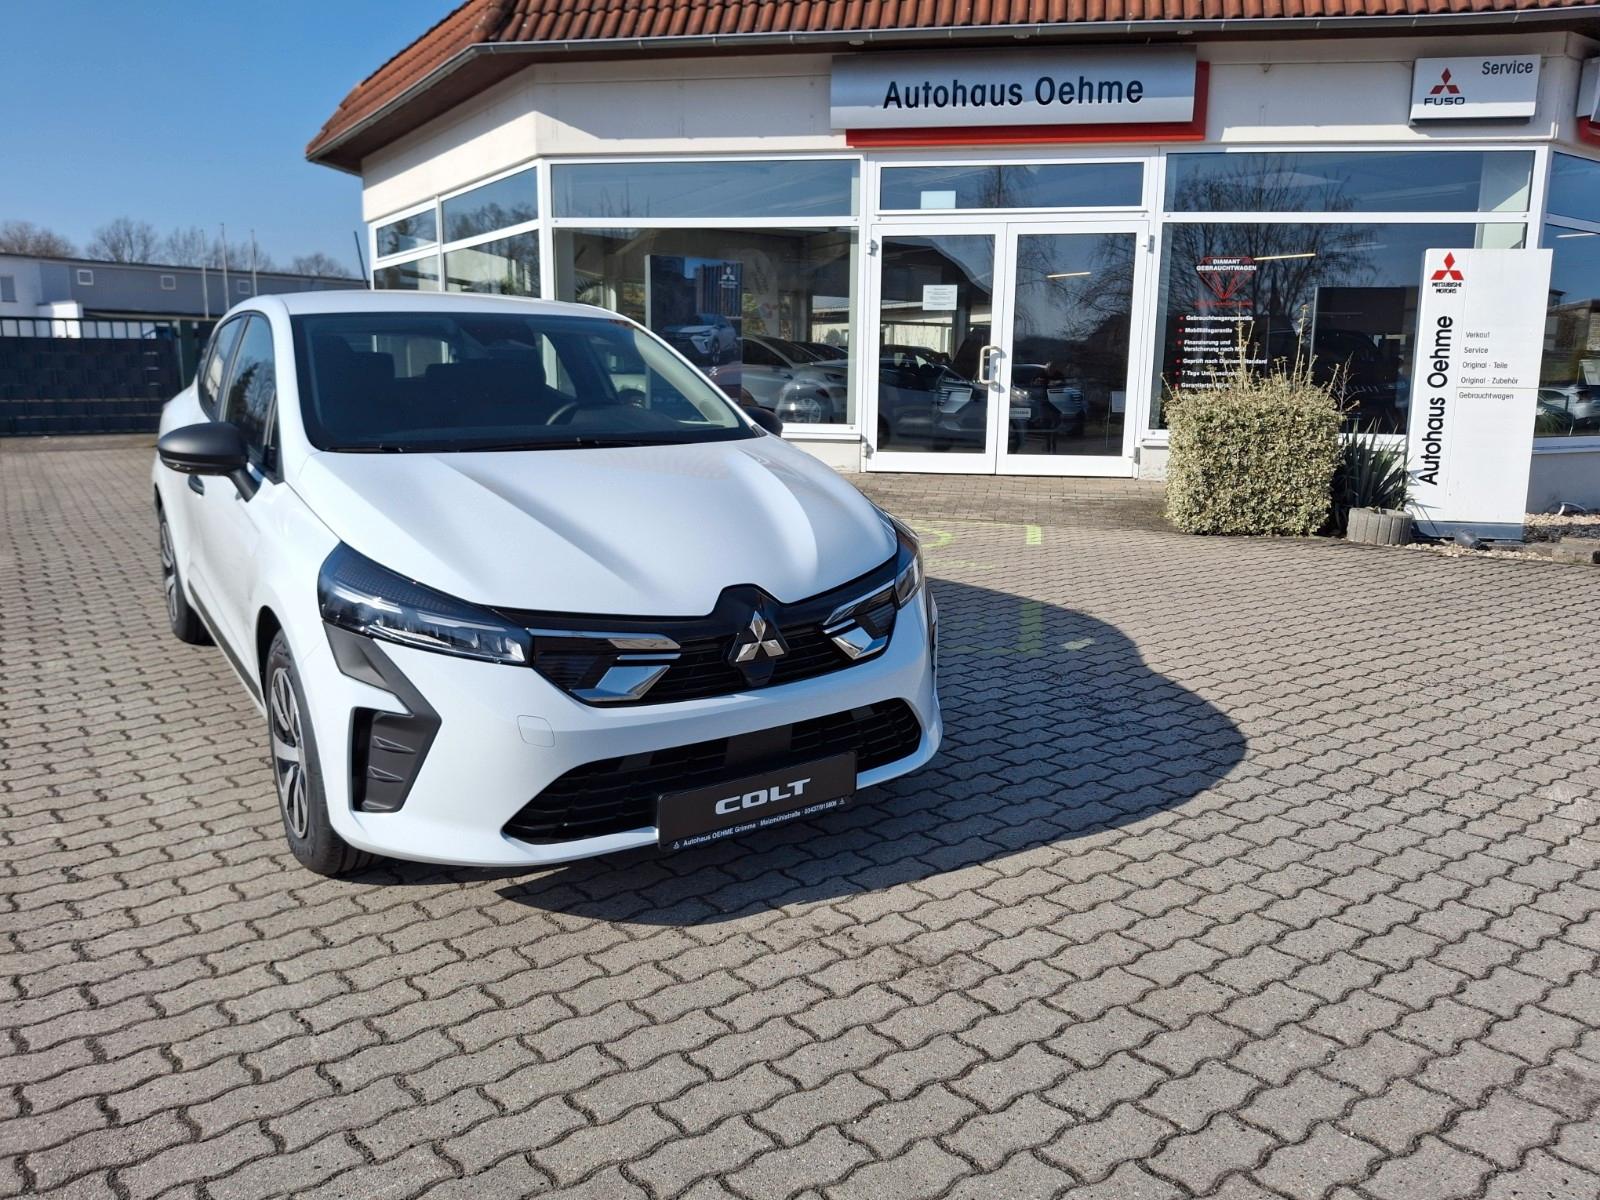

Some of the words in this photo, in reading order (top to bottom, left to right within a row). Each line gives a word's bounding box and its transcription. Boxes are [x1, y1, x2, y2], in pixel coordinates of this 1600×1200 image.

[1481, 60, 1533, 75] Service
[883, 79, 1023, 109] Autohaus
[1035, 76, 1143, 105] Oehme
[1424, 97, 1465, 106] FUSO
[1427, 315, 1453, 388] Oehme
[1462, 361, 1487, 369] Original
[1494, 361, 1508, 369] Teile
[1460, 377, 1486, 385] Original
[1491, 377, 1519, 385] Zubehör
[1459, 392, 1514, 400] Gebrauchtwagen
[1418, 397, 1446, 485] Autohaus
[715, 777, 811, 815] COLT
[683, 834, 711, 846] Autohaus
[712, 827, 734, 839] OEHME
